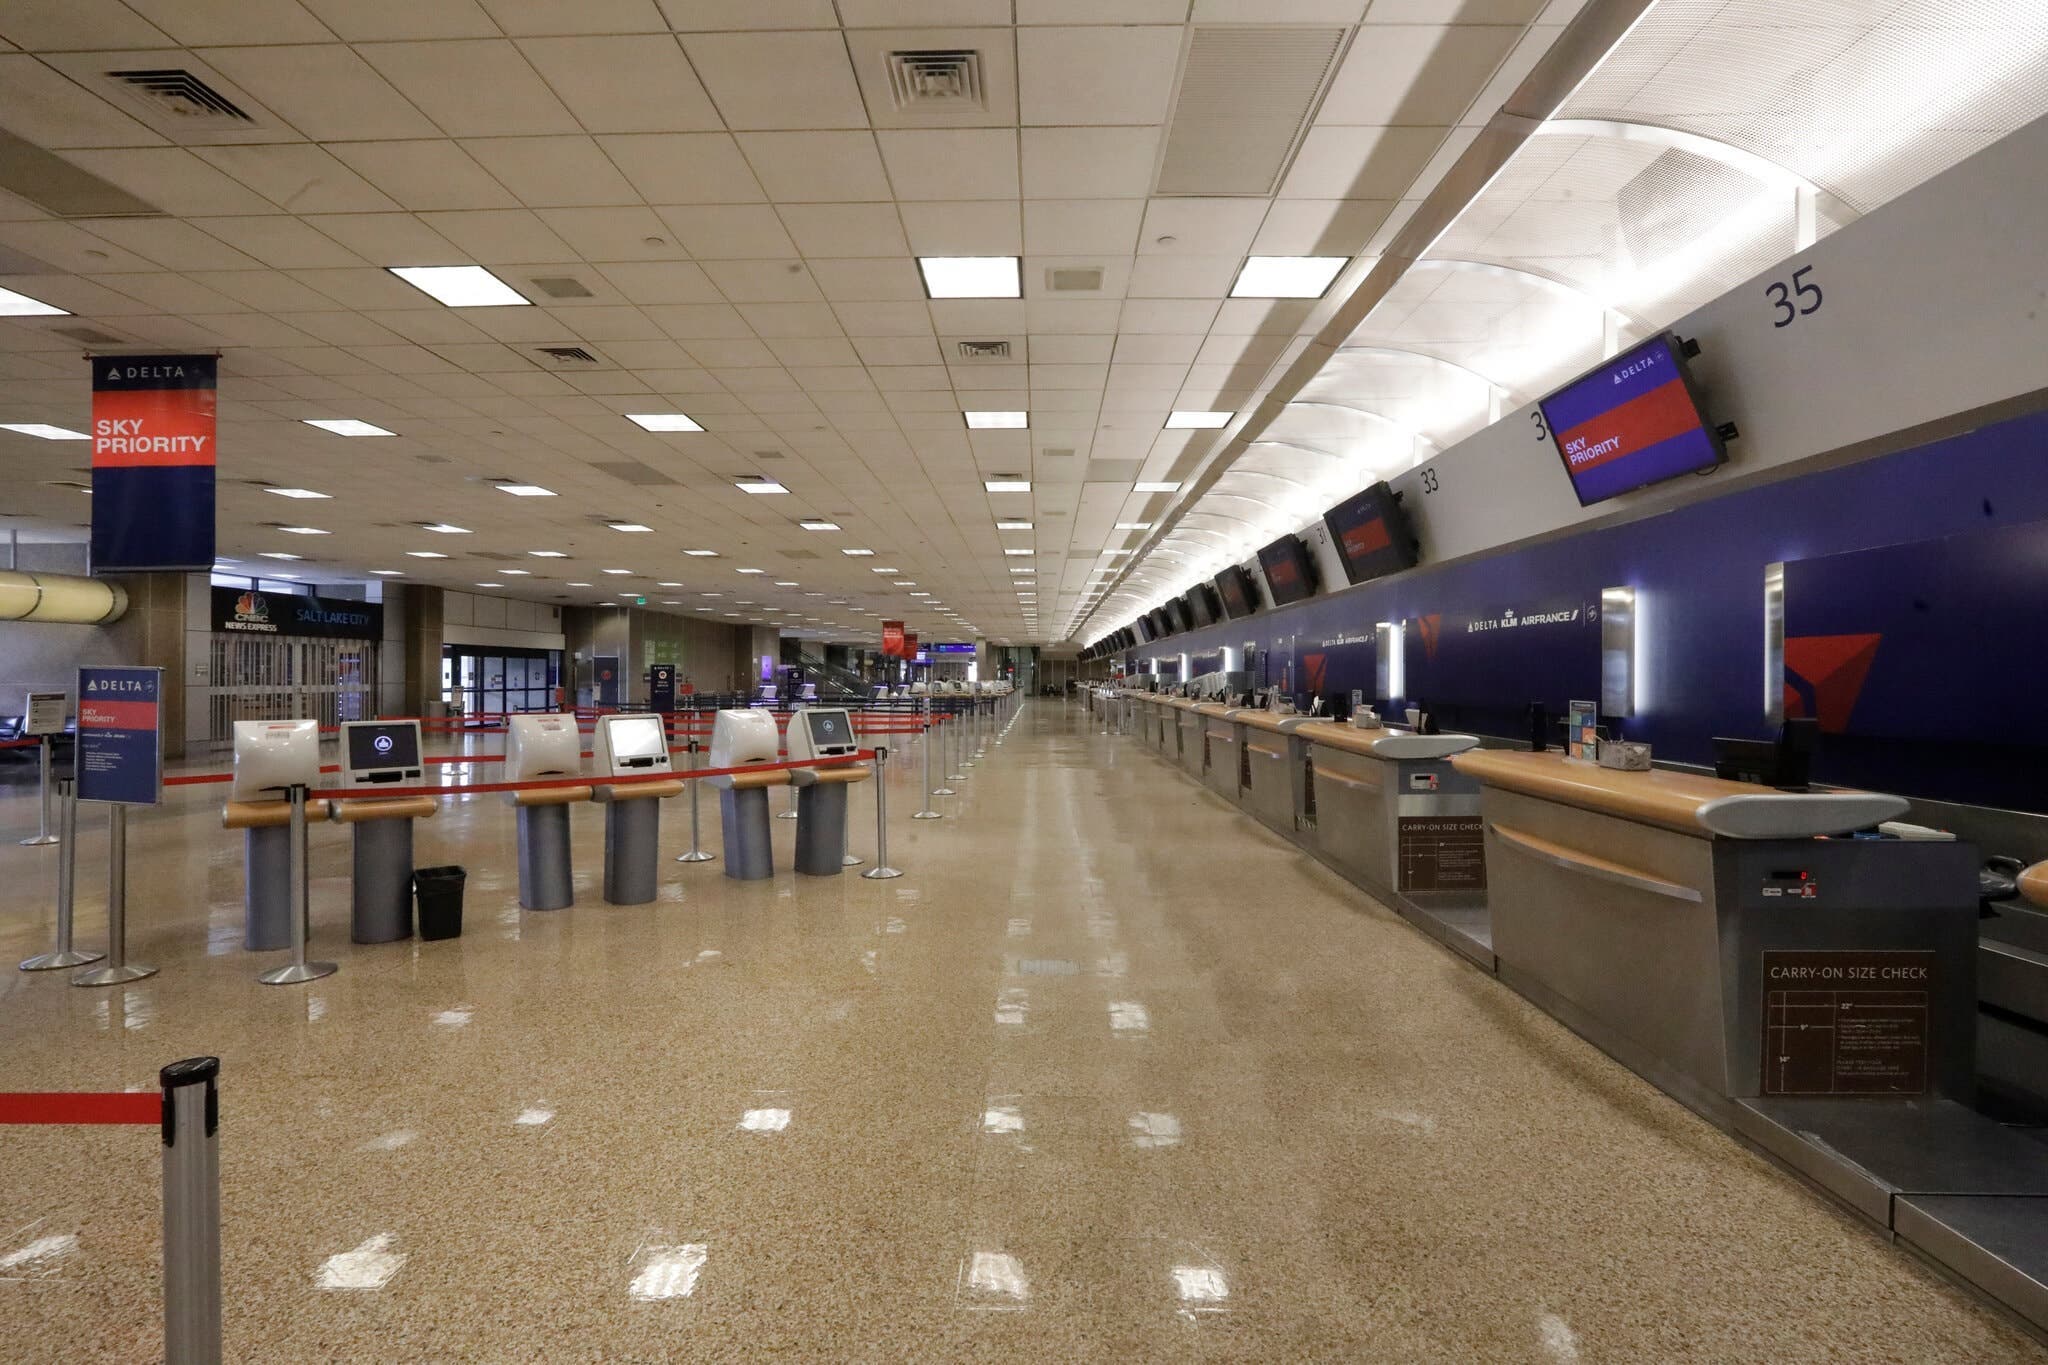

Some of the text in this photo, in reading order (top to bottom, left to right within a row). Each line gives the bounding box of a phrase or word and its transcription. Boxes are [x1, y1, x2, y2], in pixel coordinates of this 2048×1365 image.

[1765, 264, 1823, 328] 35
[127, 366, 185, 378] DELTA
[1621, 357, 1654, 379] DELTA
[96, 419, 144, 436] SKY
[1530, 411, 1550, 441] 3
[96, 435, 207, 454] PRIORITY
[1565, 437, 1586, 454] SKY
[1570, 436, 1620, 466] PRIORITY
[1420, 468, 1439, 494] 33
[296, 608, 370, 626] SALT LAKE CITY
[1474, 611, 1571, 632] DELTA KLM AIRFRANCE
[225, 621, 278, 632] NEWS EXPRESS
[101, 680, 142, 692] DELTA
[82, 708, 97, 716] SKY
[82, 715, 115, 723] PRIORITY
[1401, 823, 1440, 831] CARRY-ON
[1442, 823, 1458, 831] SIZE
[1770, 967, 1928, 979] CARRY-ON SIZE CHECK
